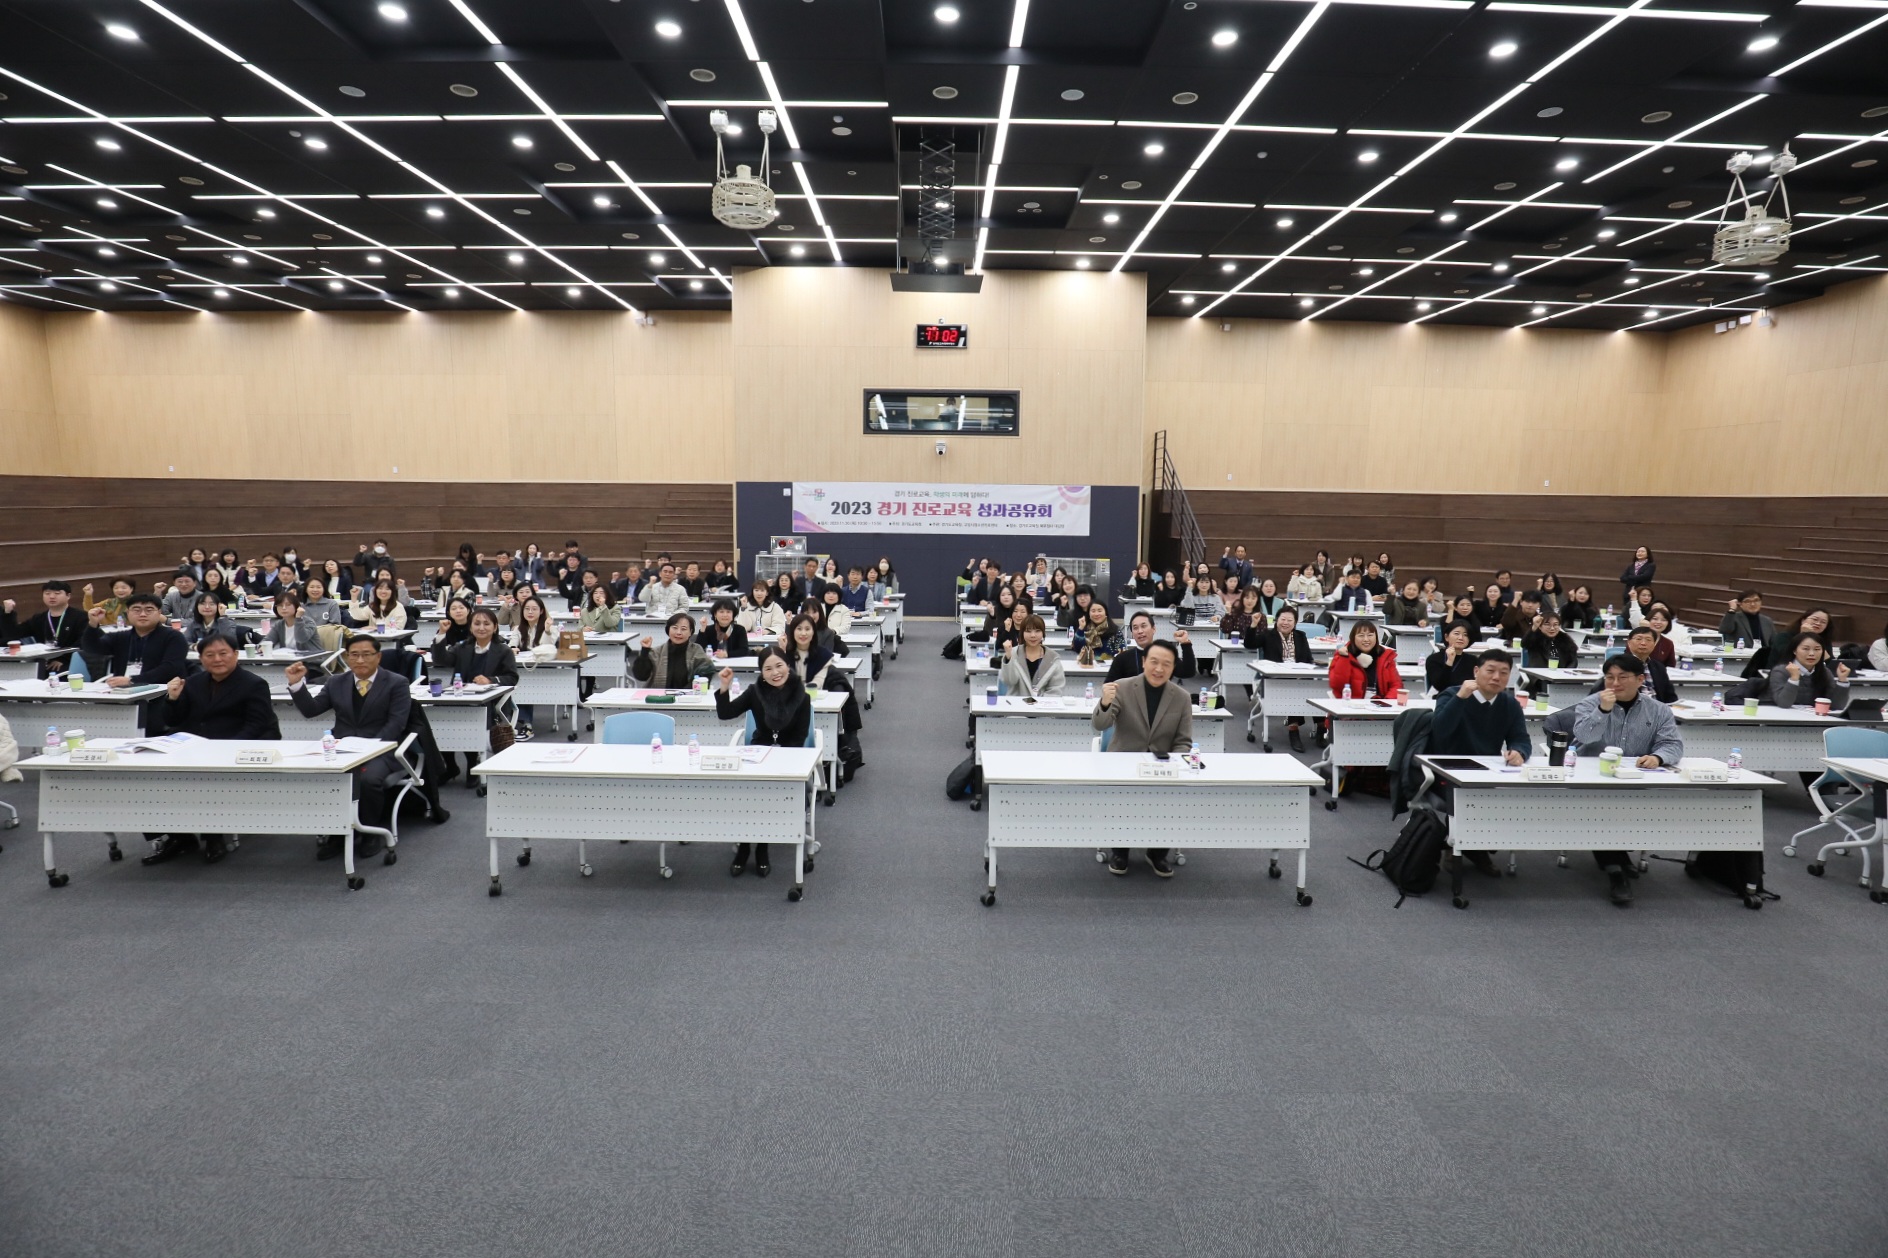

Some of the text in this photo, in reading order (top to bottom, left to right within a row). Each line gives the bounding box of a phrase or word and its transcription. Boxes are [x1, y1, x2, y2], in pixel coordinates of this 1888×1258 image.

[830, 501, 1052, 518] 2023 경기 진로교육 성과공유회
[322, 612, 329, 620] C
